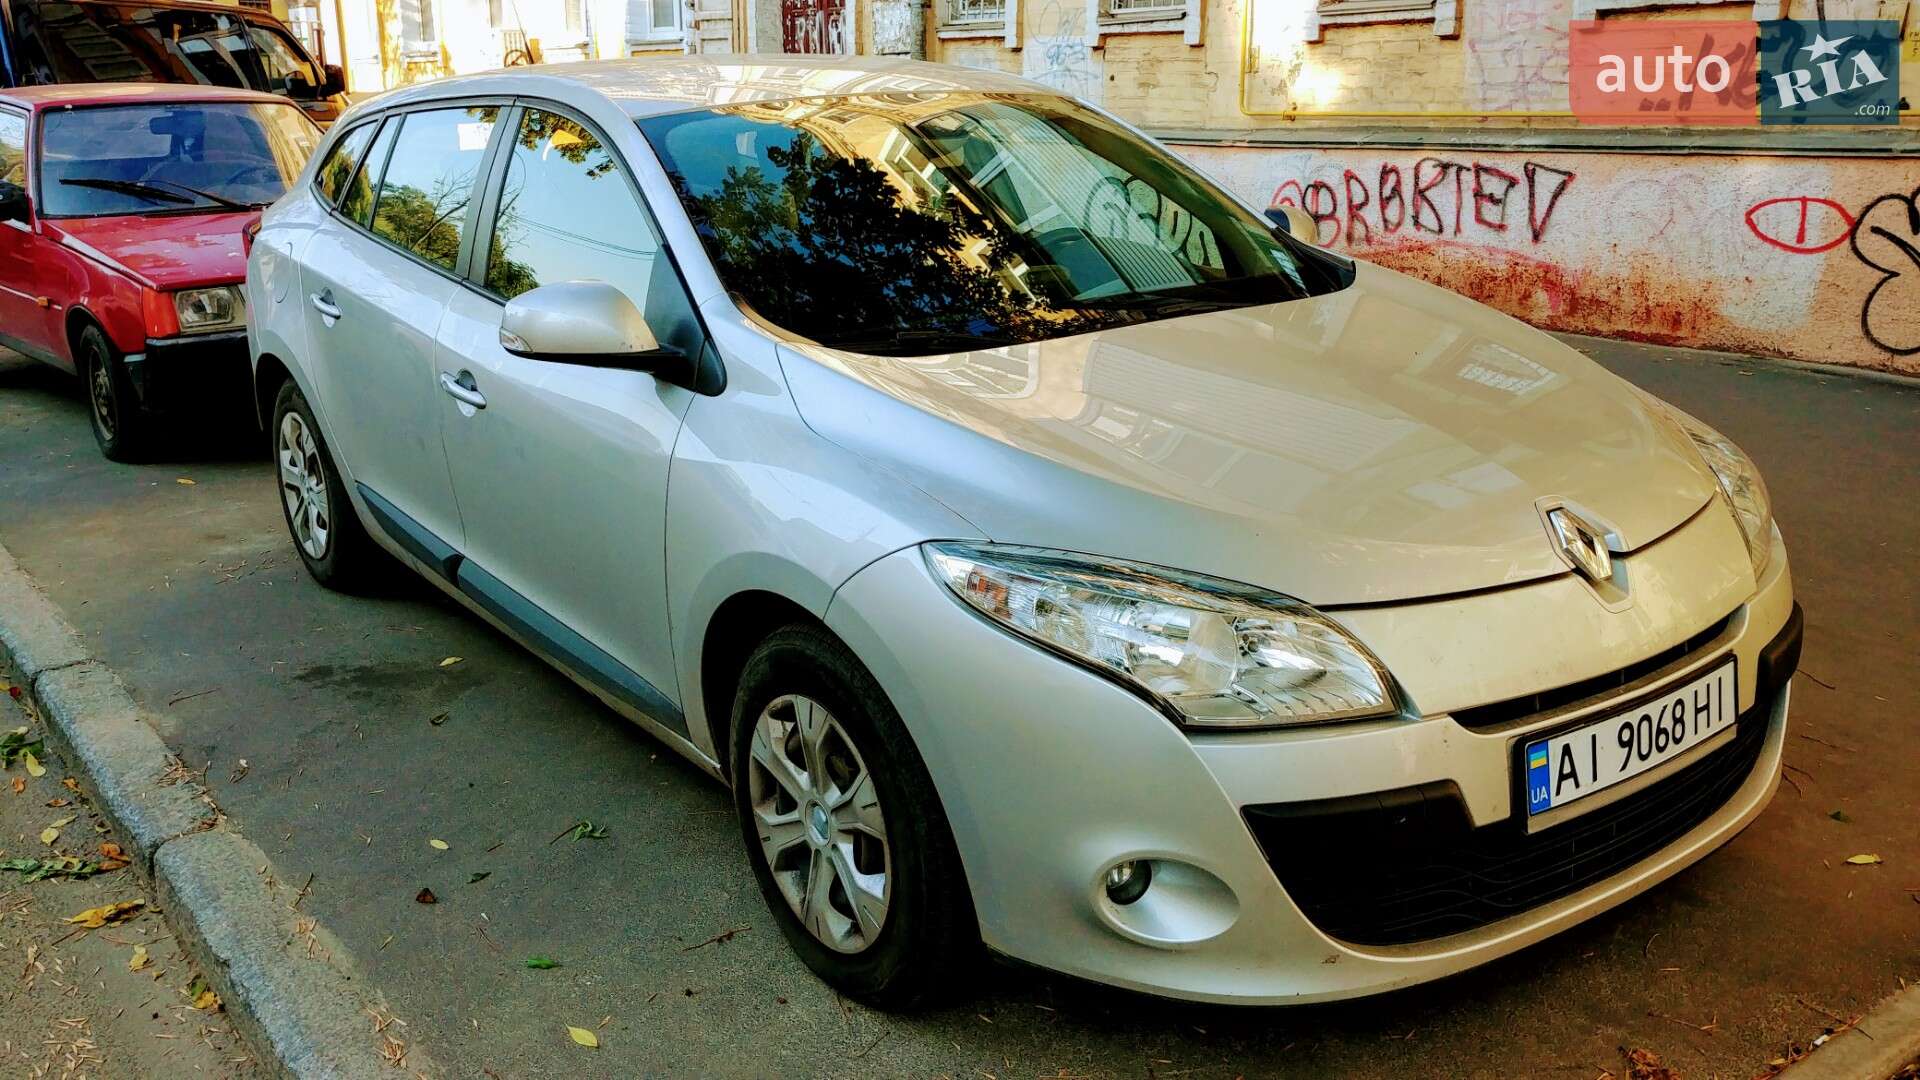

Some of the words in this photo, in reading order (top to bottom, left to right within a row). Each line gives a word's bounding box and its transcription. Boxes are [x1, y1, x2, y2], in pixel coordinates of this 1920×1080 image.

[1555, 733, 1598, 797] AI
[1617, 697, 1686, 773] 9068
[1694, 676, 1722, 736] HI
[1531, 785, 1549, 804] UA
